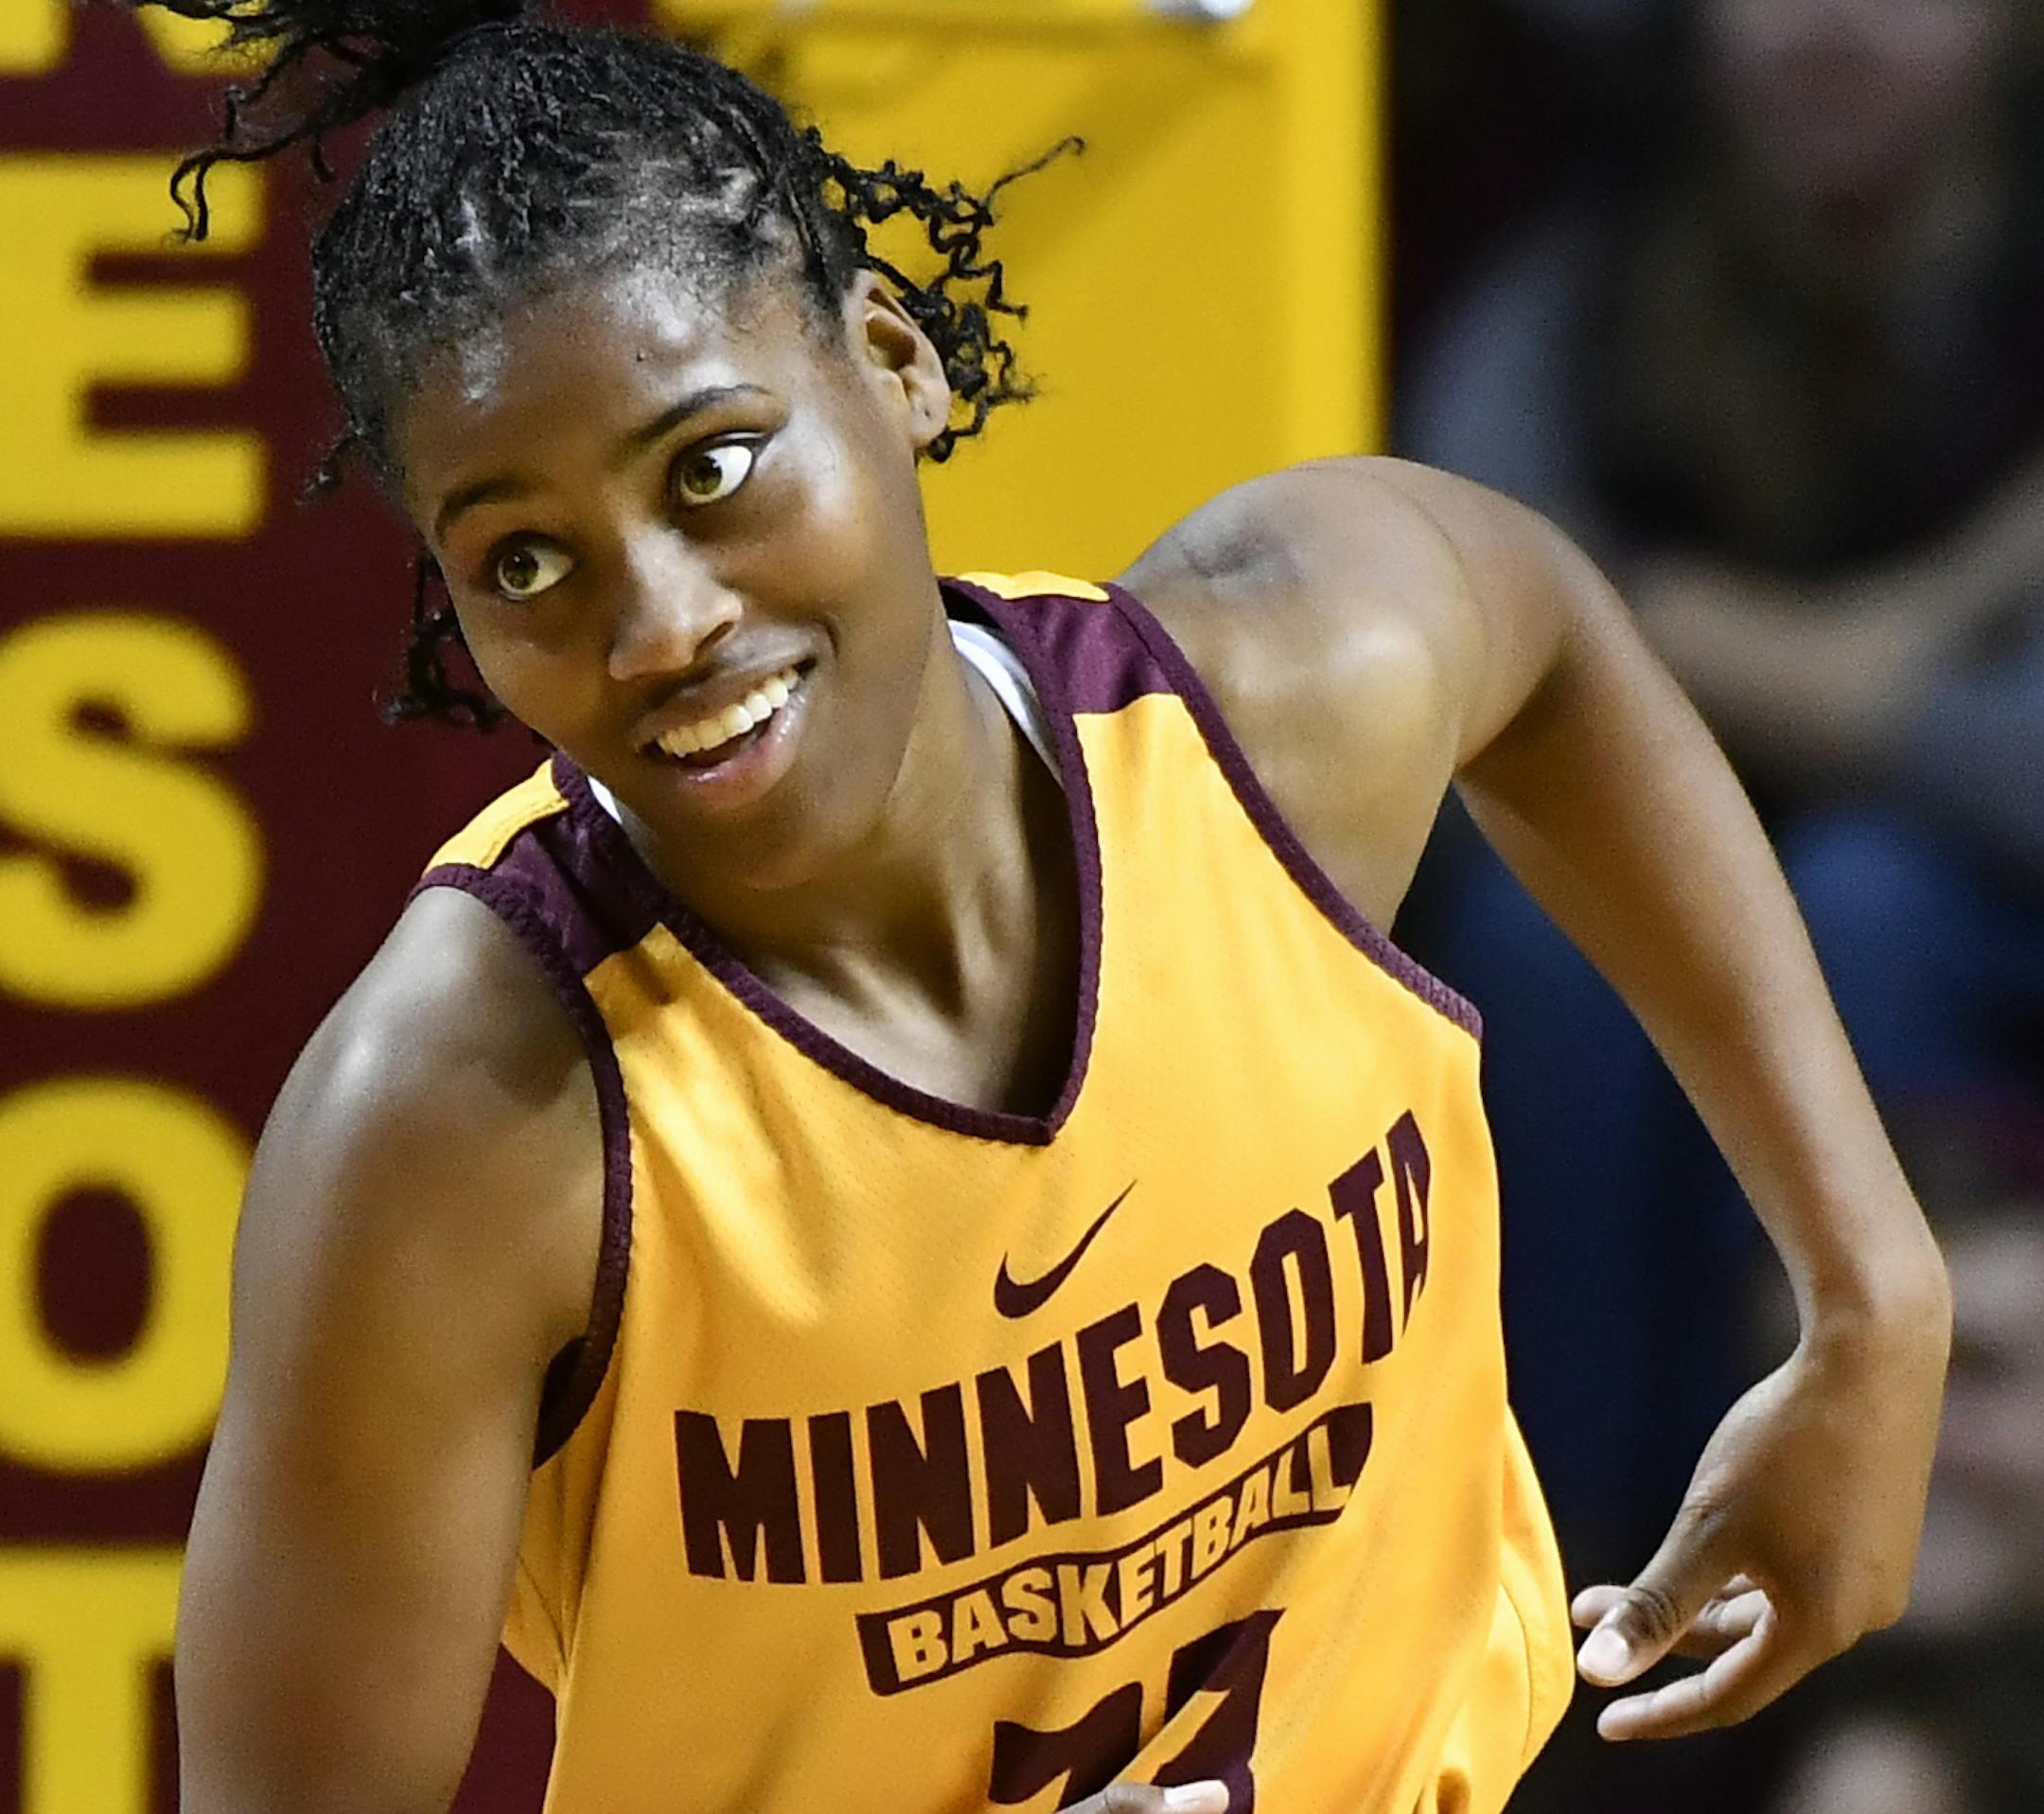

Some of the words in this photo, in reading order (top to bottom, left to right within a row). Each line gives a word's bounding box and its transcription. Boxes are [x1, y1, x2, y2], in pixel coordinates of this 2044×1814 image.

[0, 0, 267, 1814] ESOT
[675, 1109, 1432, 1585] MINNESOTA
[887, 1425, 1353, 1683] BASKETBALL
